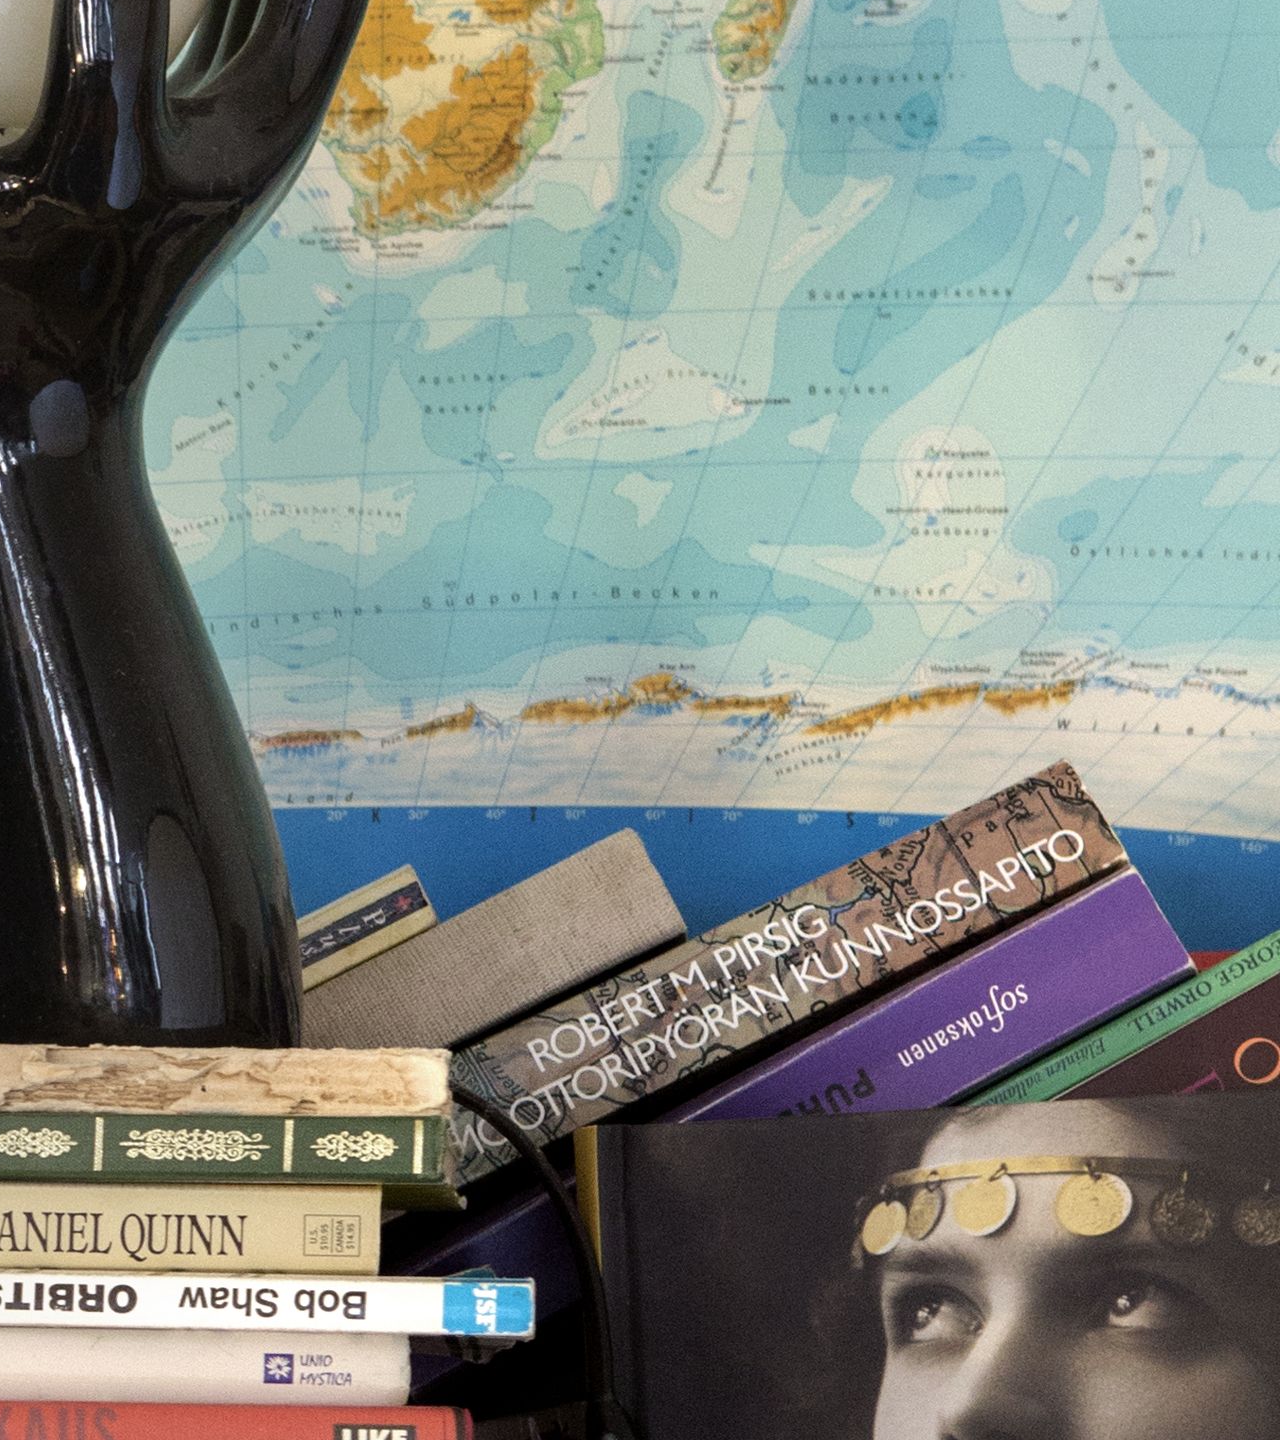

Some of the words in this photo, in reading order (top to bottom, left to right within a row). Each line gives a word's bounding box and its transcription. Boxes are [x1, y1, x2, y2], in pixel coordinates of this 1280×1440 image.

[790, 824, 1088, 994] KUNNOSSAPITO
[526, 975, 665, 1073] ROBERT
[712, 903, 830, 982] PIRSIG
[1126, 979, 1214, 1035] ORWELL
[120, 1212, 249, 1261] QUINN
[178, 1287, 283, 1316] Shaw
[294, 1290, 368, 1320] Bob
[298, 1368, 353, 1388] MYSTICA
[299, 1353, 335, 1370] UNIO
